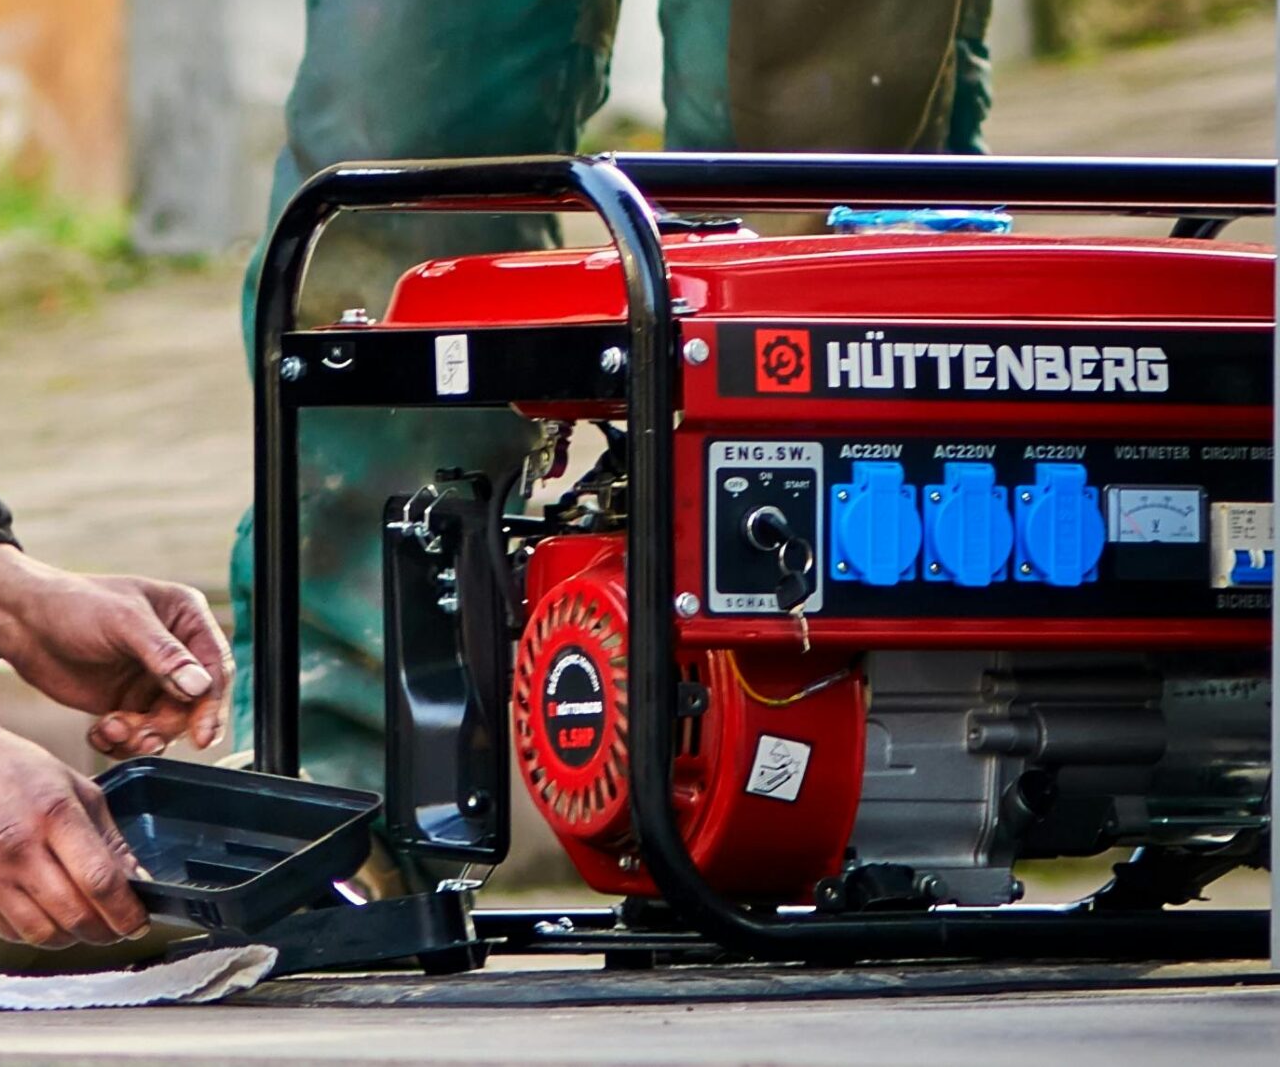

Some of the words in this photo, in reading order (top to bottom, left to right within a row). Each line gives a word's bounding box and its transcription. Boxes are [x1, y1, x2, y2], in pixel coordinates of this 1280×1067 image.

[826, 331, 1169, 392] HÜTTENBERG
[724, 446, 811, 461] ENG.SW.
[840, 444, 903, 459] AC220V
[933, 444, 996, 459] AC220V
[1023, 445, 1087, 460] AC220V
[1114, 445, 1190, 460] VOLTMETER
[1200, 445, 1249, 461] CIRCUIT
[783, 480, 810, 490] START
[725, 597, 778, 609] SCHAL
